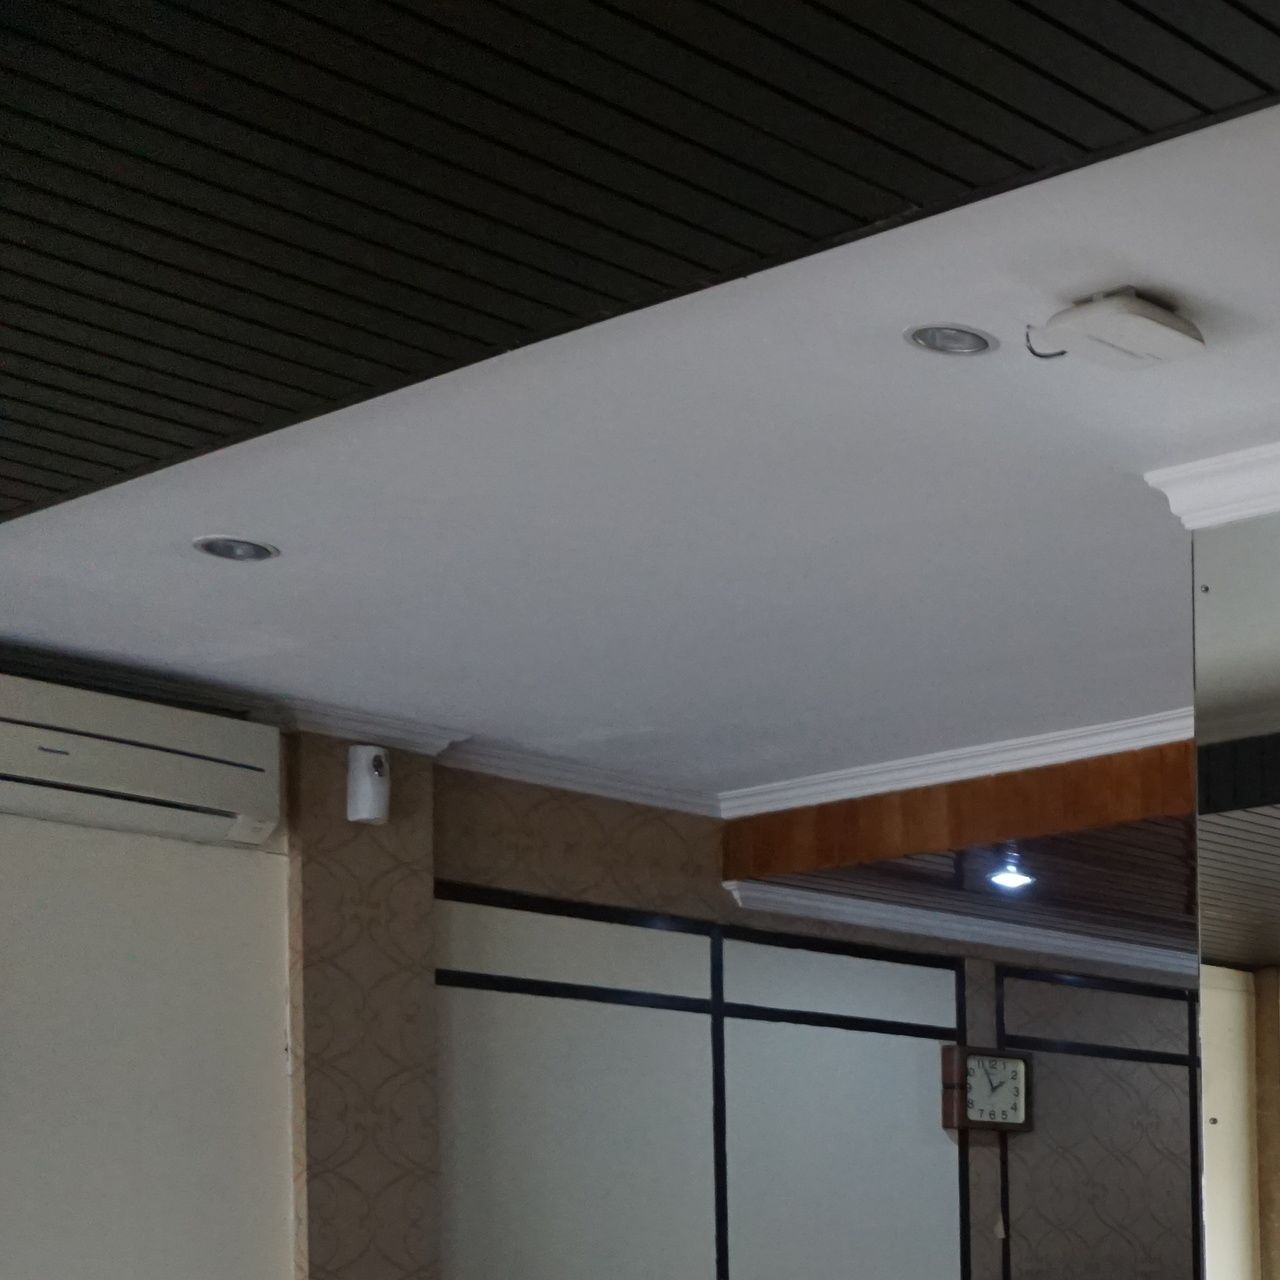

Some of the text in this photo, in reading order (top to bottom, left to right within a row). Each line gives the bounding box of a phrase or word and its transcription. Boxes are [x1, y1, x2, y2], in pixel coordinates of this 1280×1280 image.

[977, 1058, 985, 1069] 11
[988, 1059, 997, 1069] 12
[1010, 1070, 1018, 1080] 2
[1013, 1086, 1020, 1097] 3
[967, 1099, 975, 1109] 8
[1010, 1102, 1018, 1112] 4
[978, 1109, 984, 1119] 7
[989, 1109, 996, 1120] 6
[1001, 1110, 1008, 1120] 5
